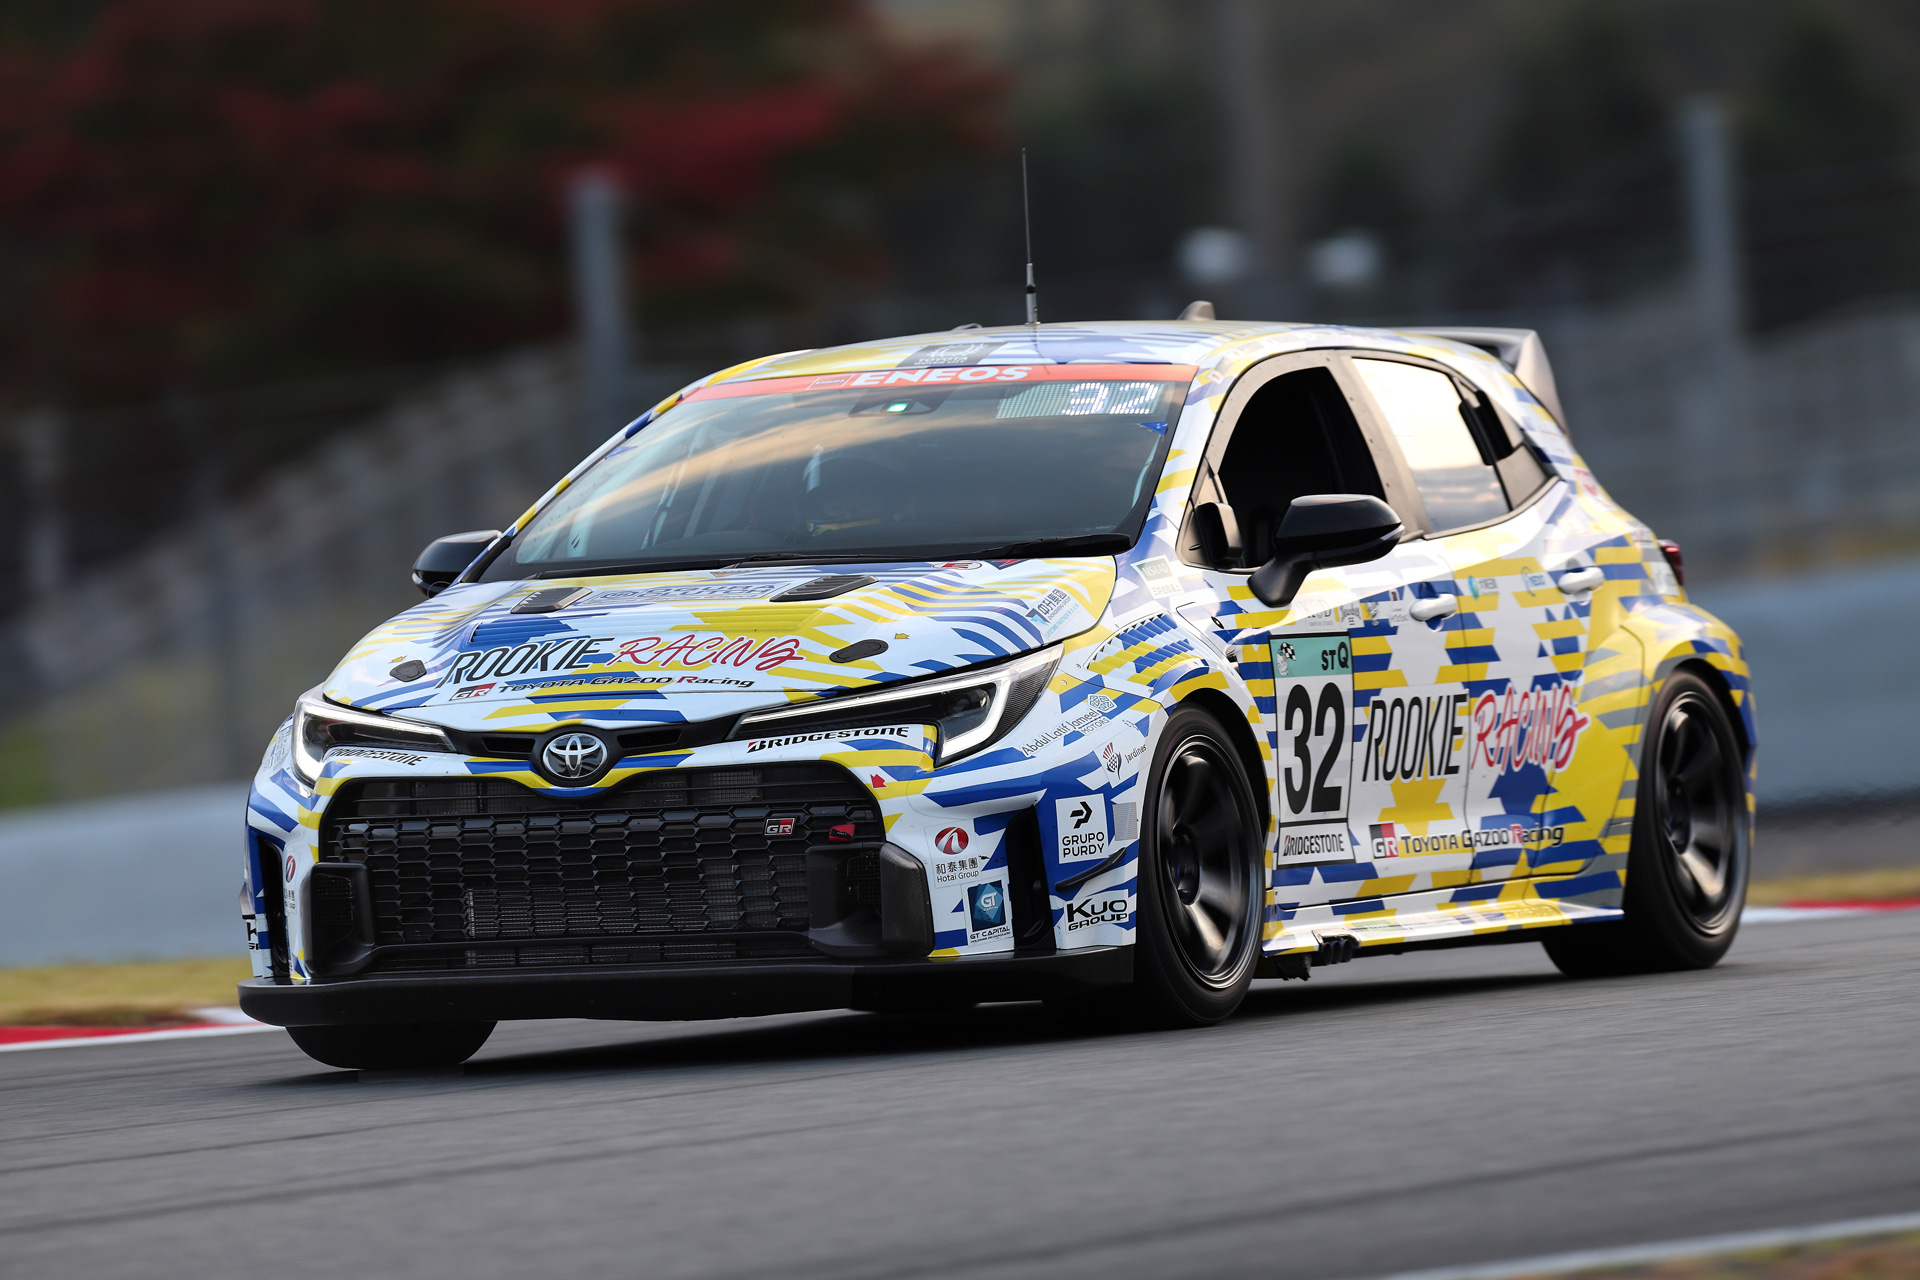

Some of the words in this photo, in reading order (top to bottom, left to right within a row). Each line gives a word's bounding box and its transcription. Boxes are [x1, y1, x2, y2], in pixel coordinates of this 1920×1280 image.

[850, 366, 1033, 387] ENEOS
[1061, 382, 1159, 416] 32
[435, 637, 615, 689] ROOKIE
[605, 634, 804, 671] RACING
[452, 686, 493, 700] GR
[499, 679, 585, 693] TOYOTA
[590, 676, 673, 685] GAZOO
[676, 676, 755, 688] Racing
[1021, 732, 1052, 756] Abdul
[1050, 721, 1071, 740] Latif
[1069, 708, 1101, 730] Jameel
[1080, 717, 1111, 735] MOTORS
[1362, 693, 1468, 782] ROOKIE
[1470, 684, 1589, 771] RACING
[747, 726, 909, 753] BRIDGESTONE
[1284, 682, 1346, 815] 32
[1125, 744, 1147, 763] Jardines
[766, 821, 793, 834] GR
[1062, 831, 1105, 846] GRUPO
[1283, 833, 1345, 857] BRIDGESTONE
[1370, 831, 1399, 858] GR
[1401, 834, 1459, 854] TOYOTA
[1461, 829, 1509, 848] GAZOO
[1510, 823, 1565, 846] Racing
[1063, 843, 1105, 858] PURDY
[936, 857, 978, 874] 和泰集團
[936, 873, 957, 883] Hotai
[958, 870, 979, 880] Group
[980, 891, 998, 908] GT
[1068, 913, 1128, 931] GROUP
[970, 932, 980, 940] GT
[981, 926, 1011, 937] CAPITAL
